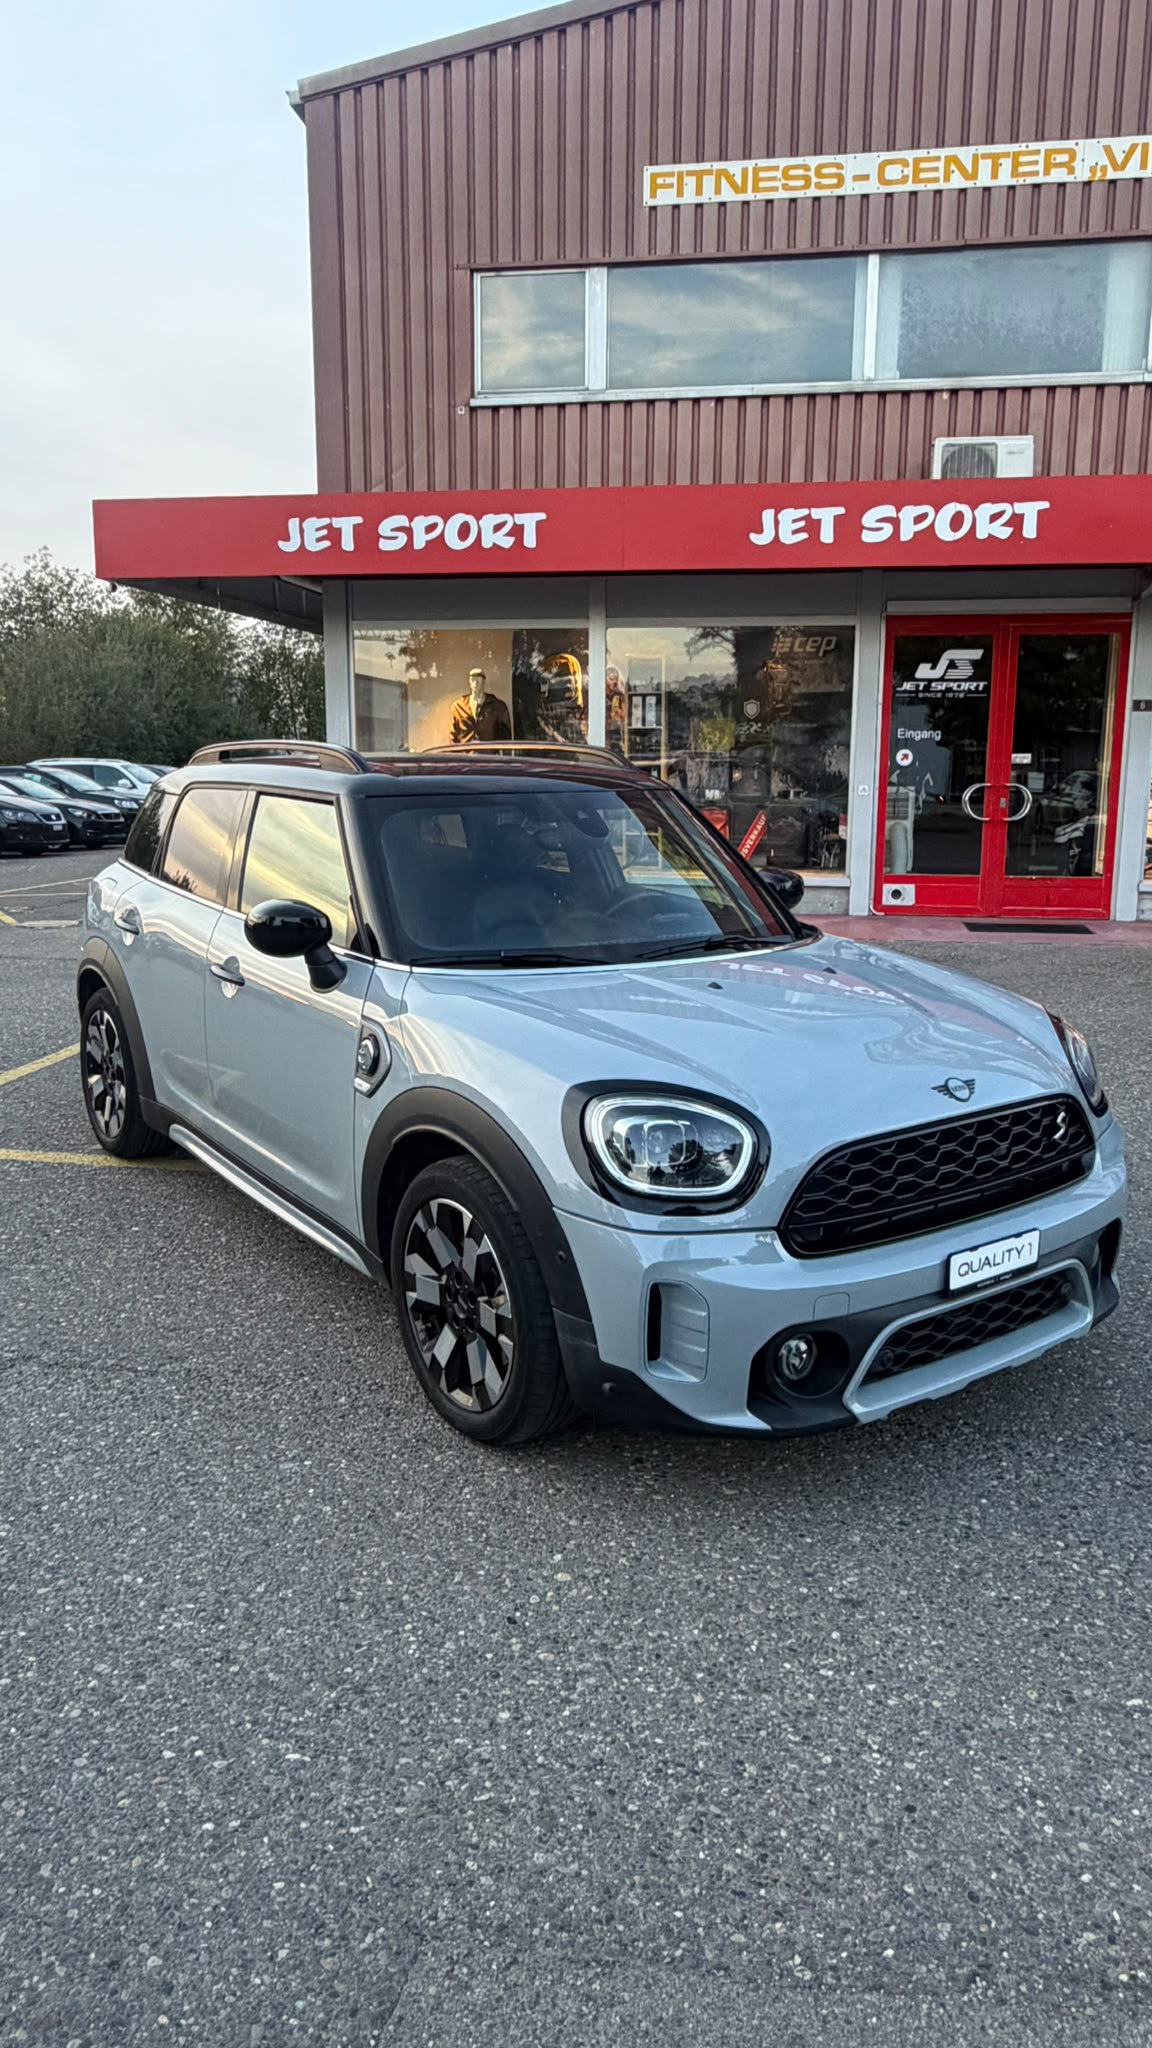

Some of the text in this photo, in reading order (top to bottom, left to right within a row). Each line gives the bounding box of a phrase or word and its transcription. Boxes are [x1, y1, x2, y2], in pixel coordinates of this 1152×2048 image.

[277, 512, 548, 552] JET SPORT
[749, 501, 1051, 546] JET SPORT
[793, 635, 837, 657] cep
[896, 681, 988, 691] JET SPORT
[897, 727, 942, 741] Eingang
[957, 1242, 1033, 1277] QUALITY 1
